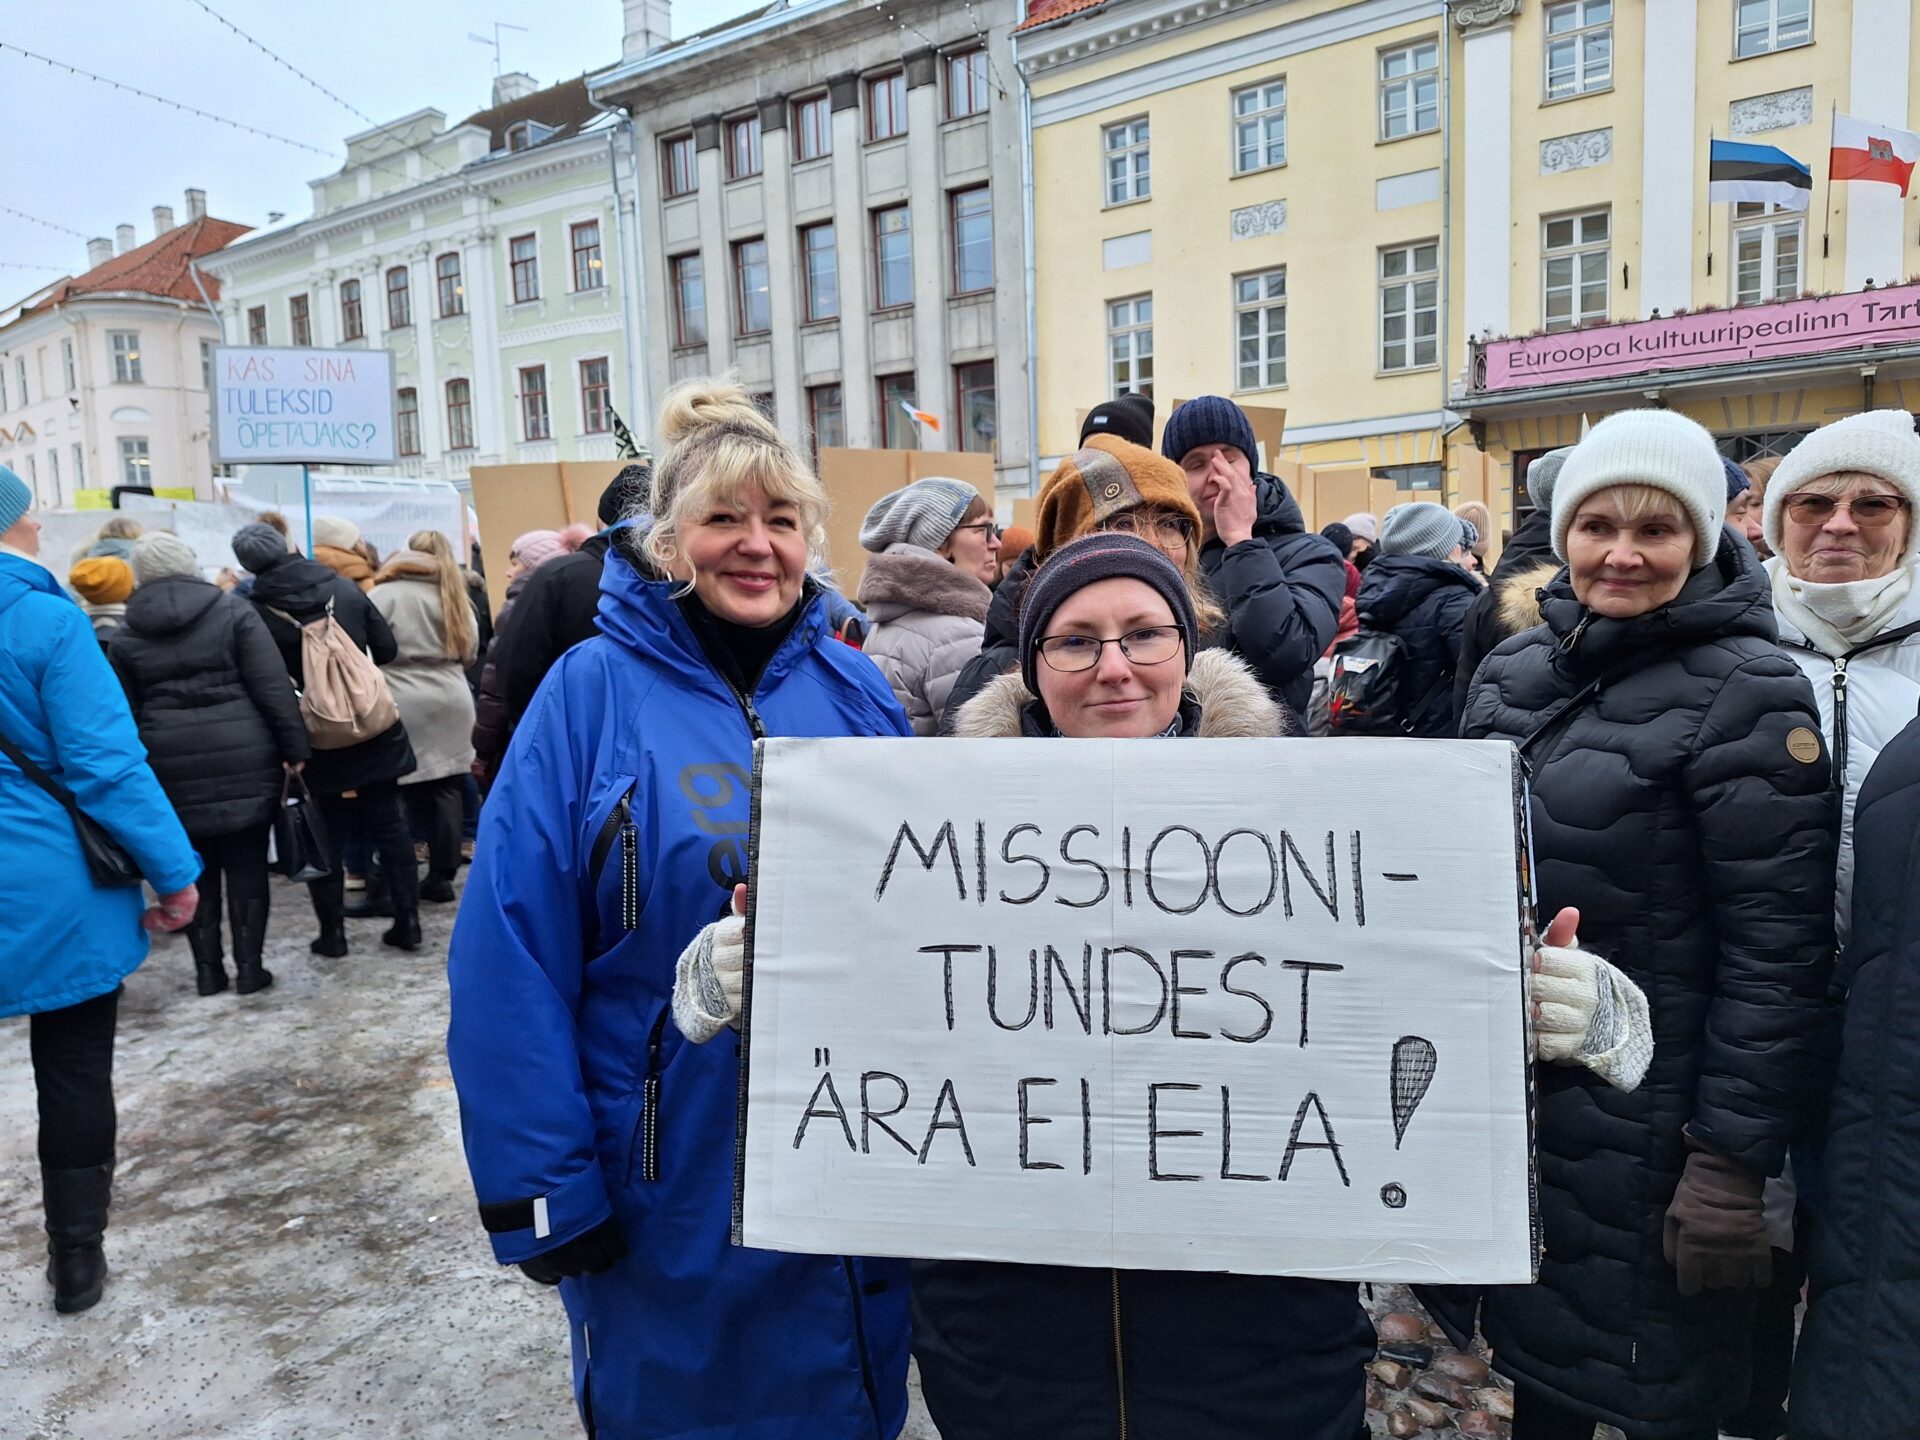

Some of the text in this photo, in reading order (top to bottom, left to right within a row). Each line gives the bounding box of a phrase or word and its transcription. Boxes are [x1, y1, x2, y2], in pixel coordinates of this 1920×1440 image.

[227, 356, 356, 383] KAS SINA
[1509, 342, 1620, 368] Euroopa
[1629, 311, 1849, 354] kultuuripealinn
[222, 387, 333, 415] TULEKSID
[874, 818, 1419, 928] MISSIOONI-
[918, 940, 1344, 1048] TUNDEST
[793, 1047, 977, 1167] ÄRA
[1018, 1077, 1093, 1176] EI
